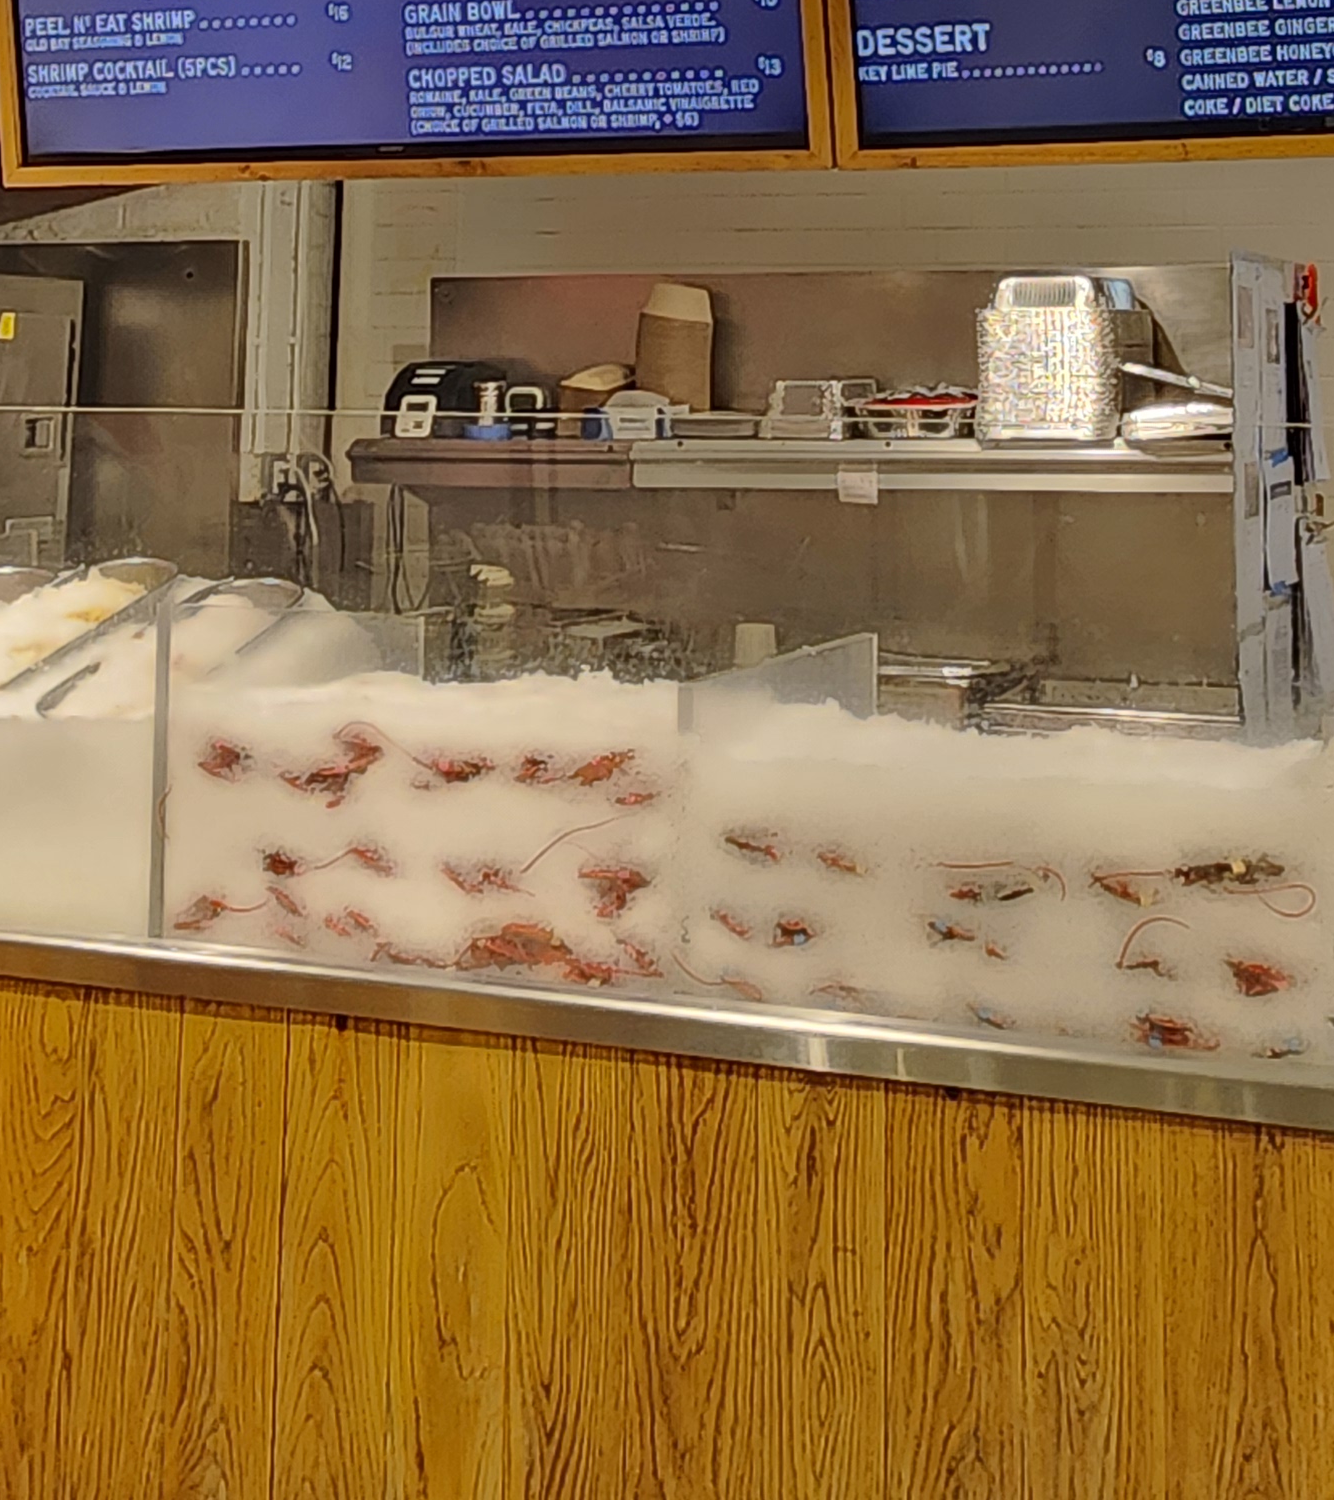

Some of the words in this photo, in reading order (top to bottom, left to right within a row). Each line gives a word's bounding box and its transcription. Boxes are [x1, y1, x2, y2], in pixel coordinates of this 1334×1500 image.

[857, 23, 990, 56] DESSERT
[1179, 20, 1270, 40] GREENBEE
[1180, 45, 1272, 65] GREENBEE
[28, 63, 88, 83] SHRIMP
[93, 59, 174, 80] COCKTAIL
[409, 67, 496, 88] CHOPPED
[502, 64, 566, 85] SALAD
[859, 65, 888, 81] KEY
[891, 63, 928, 80] LIME
[932, 61, 958, 78] PIE
